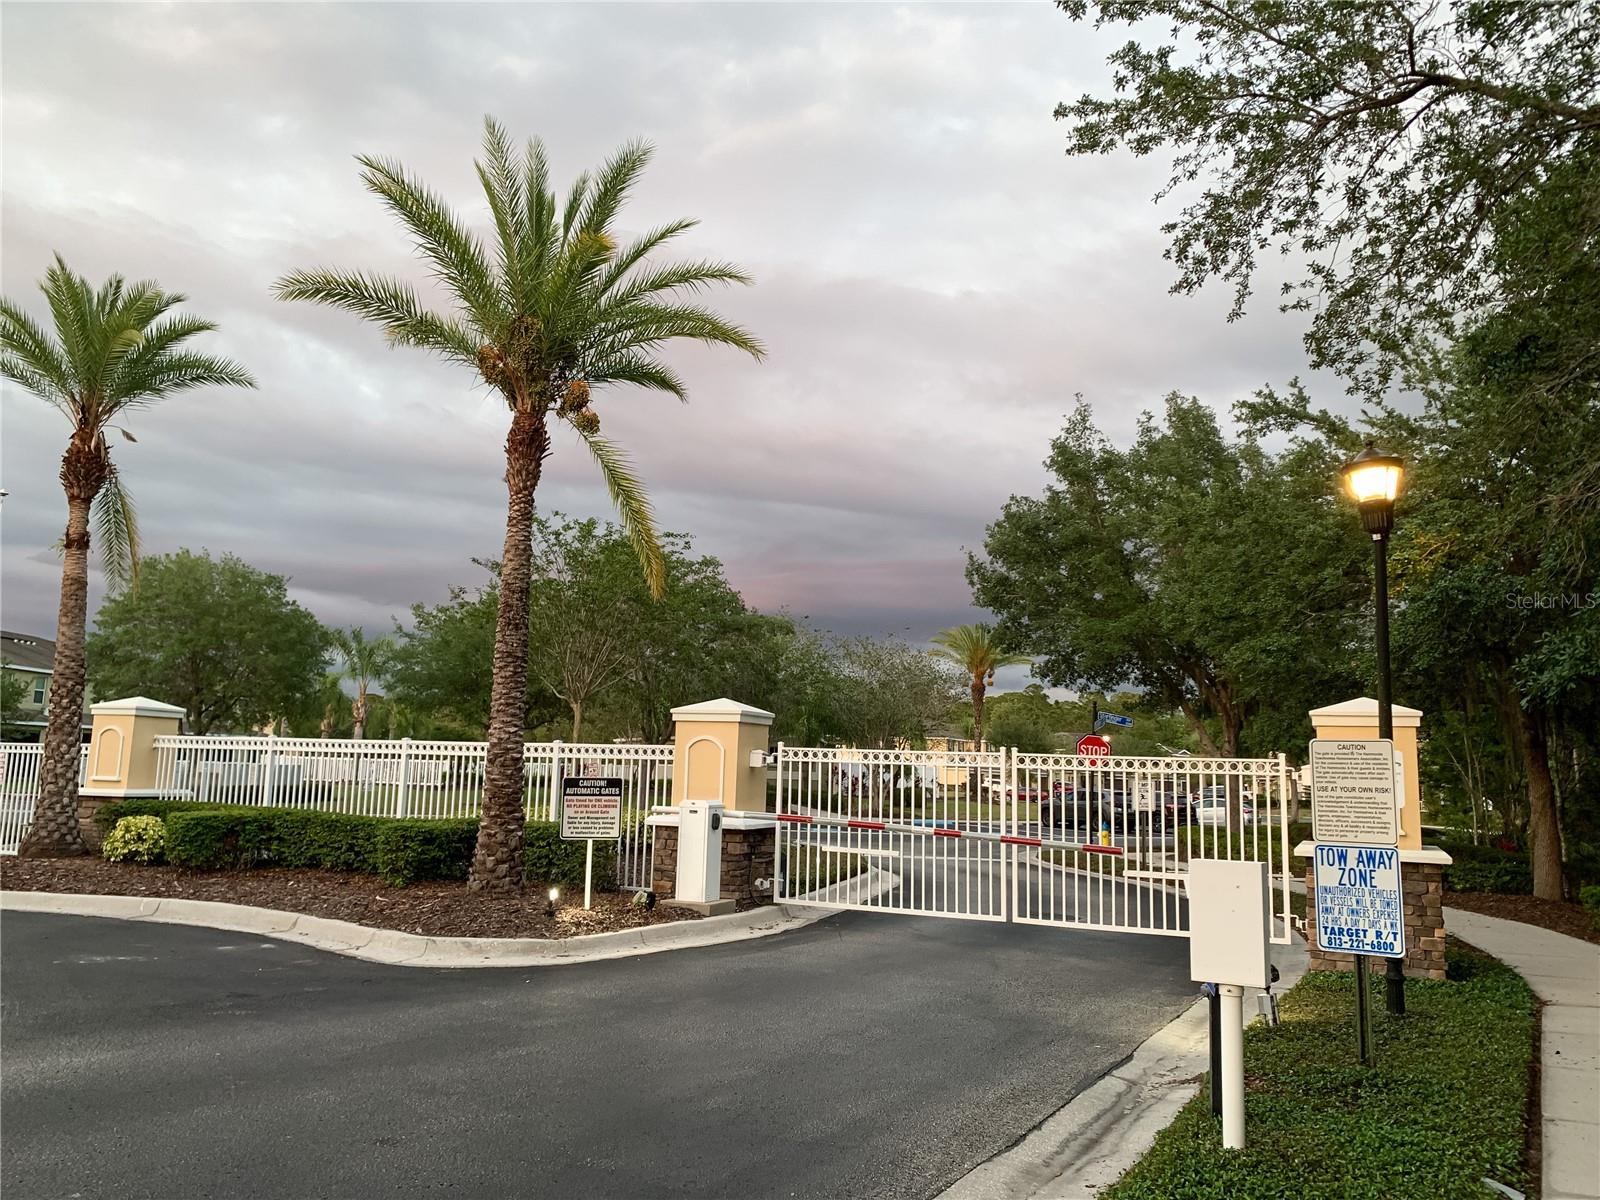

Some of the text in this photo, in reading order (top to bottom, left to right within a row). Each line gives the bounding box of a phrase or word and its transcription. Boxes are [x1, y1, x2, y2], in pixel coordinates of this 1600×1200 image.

[1080, 745, 1108, 756] STOP
[1319, 848, 1394, 870] TOW AWAY
[1338, 868, 1377, 888] ZONE
[1320, 886, 1397, 900] UNAUTHORIZED VEHICLES
[1321, 896, 1398, 910] OR VESSELS WILL BE TOWED
[1321, 906, 1398, 921] AWAY AT OWNERS EXPENSE
[1322, 916, 1328, 925] 24
[1331, 917, 1341, 926] HRS
[1351, 918, 1360, 927] DAY
[1363, 920, 1365, 928] 7
[1368, 920, 1381, 929] DAYS
[1384, 921, 1388, 929] A
[1390, 922, 1398, 930] WK
[1323, 926, 1398, 941] TARGET R/T
[1328, 937, 1394, 951] 813-221-6800
